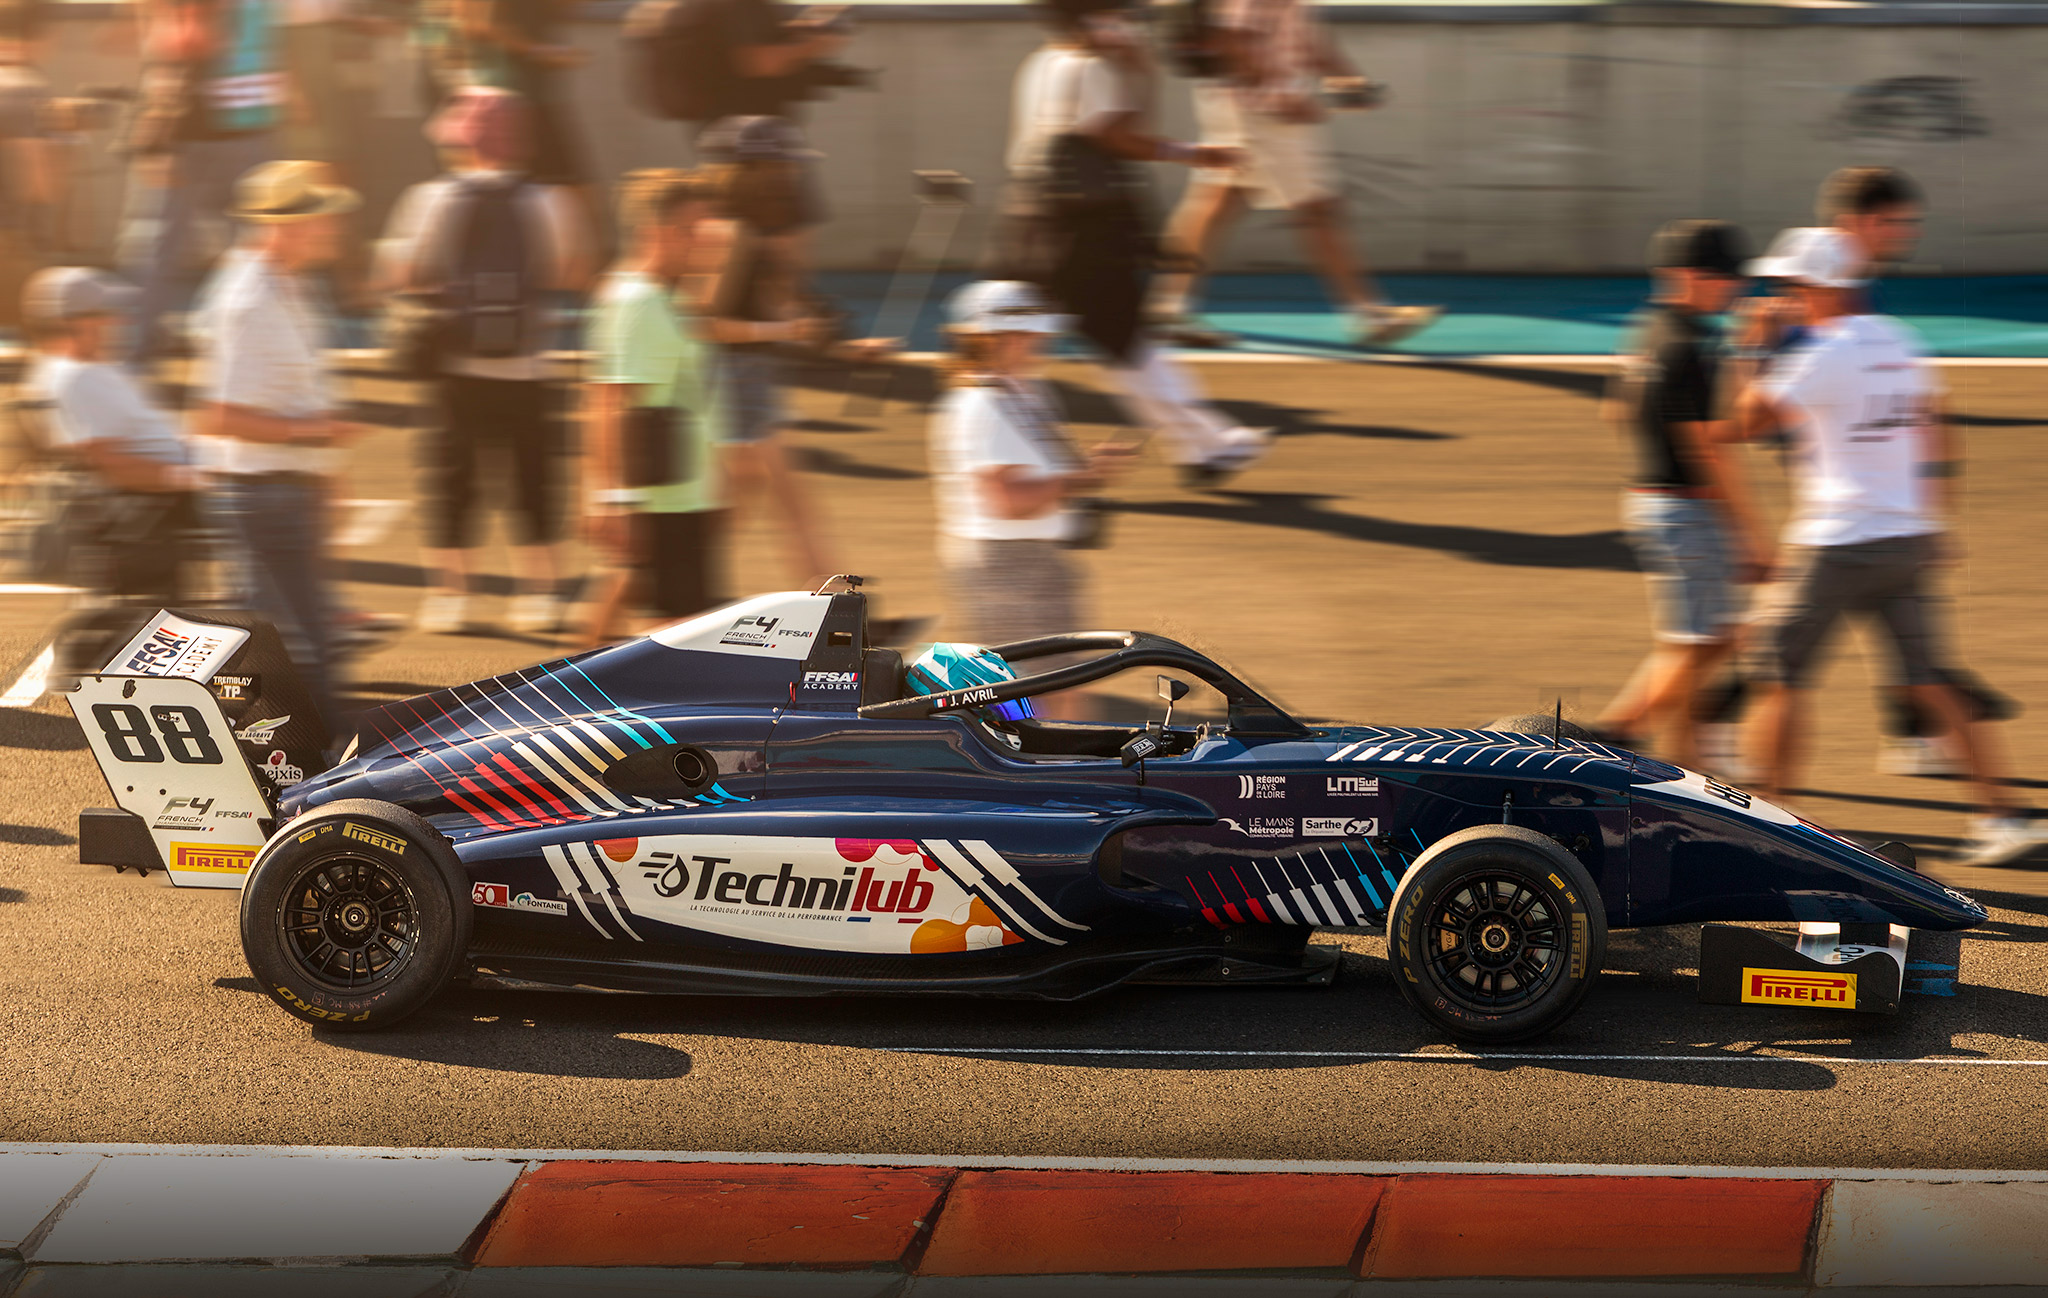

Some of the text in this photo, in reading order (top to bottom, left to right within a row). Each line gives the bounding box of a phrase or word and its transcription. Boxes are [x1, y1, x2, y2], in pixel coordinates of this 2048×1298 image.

[729, 615, 780, 633] F4
[725, 631, 768, 640] FRENCH
[172, 637, 222, 677] CADEMY
[212, 675, 253, 687] TREMBLAY
[803, 671, 857, 682] FFSA
[222, 686, 241, 698] TP
[949, 687, 998, 707] J. AVRIL
[91, 703, 224, 764] 88
[265, 766, 301, 780] eixis
[1256, 775, 1286, 784] RÉGION
[1263, 791, 1286, 799] LOIRE
[161, 796, 215, 816] F4
[157, 815, 204, 823] FRENCH
[1248, 817, 1295, 827] LE MANS
[1305, 819, 1342, 829] Sarthe
[1249, 826, 1295, 835] Métropole
[342, 822, 408, 855] PIRELLI
[692, 855, 934, 912] Technilub
[527, 901, 566, 911] FONTANEL
[699, 905, 740, 915] TECHNOLOGIE
[751, 909, 776, 918] SERVICE
[778, 911, 786, 919] DE
[797, 913, 843, 922] PERFORMANCE
[1400, 885, 1424, 984] P ZERO
[1569, 912, 1588, 980] PIRELLI
[1751, 974, 1848, 1002] PIRELLI
[276, 986, 347, 1022] ZERO
[352, 1009, 371, 1022] P
